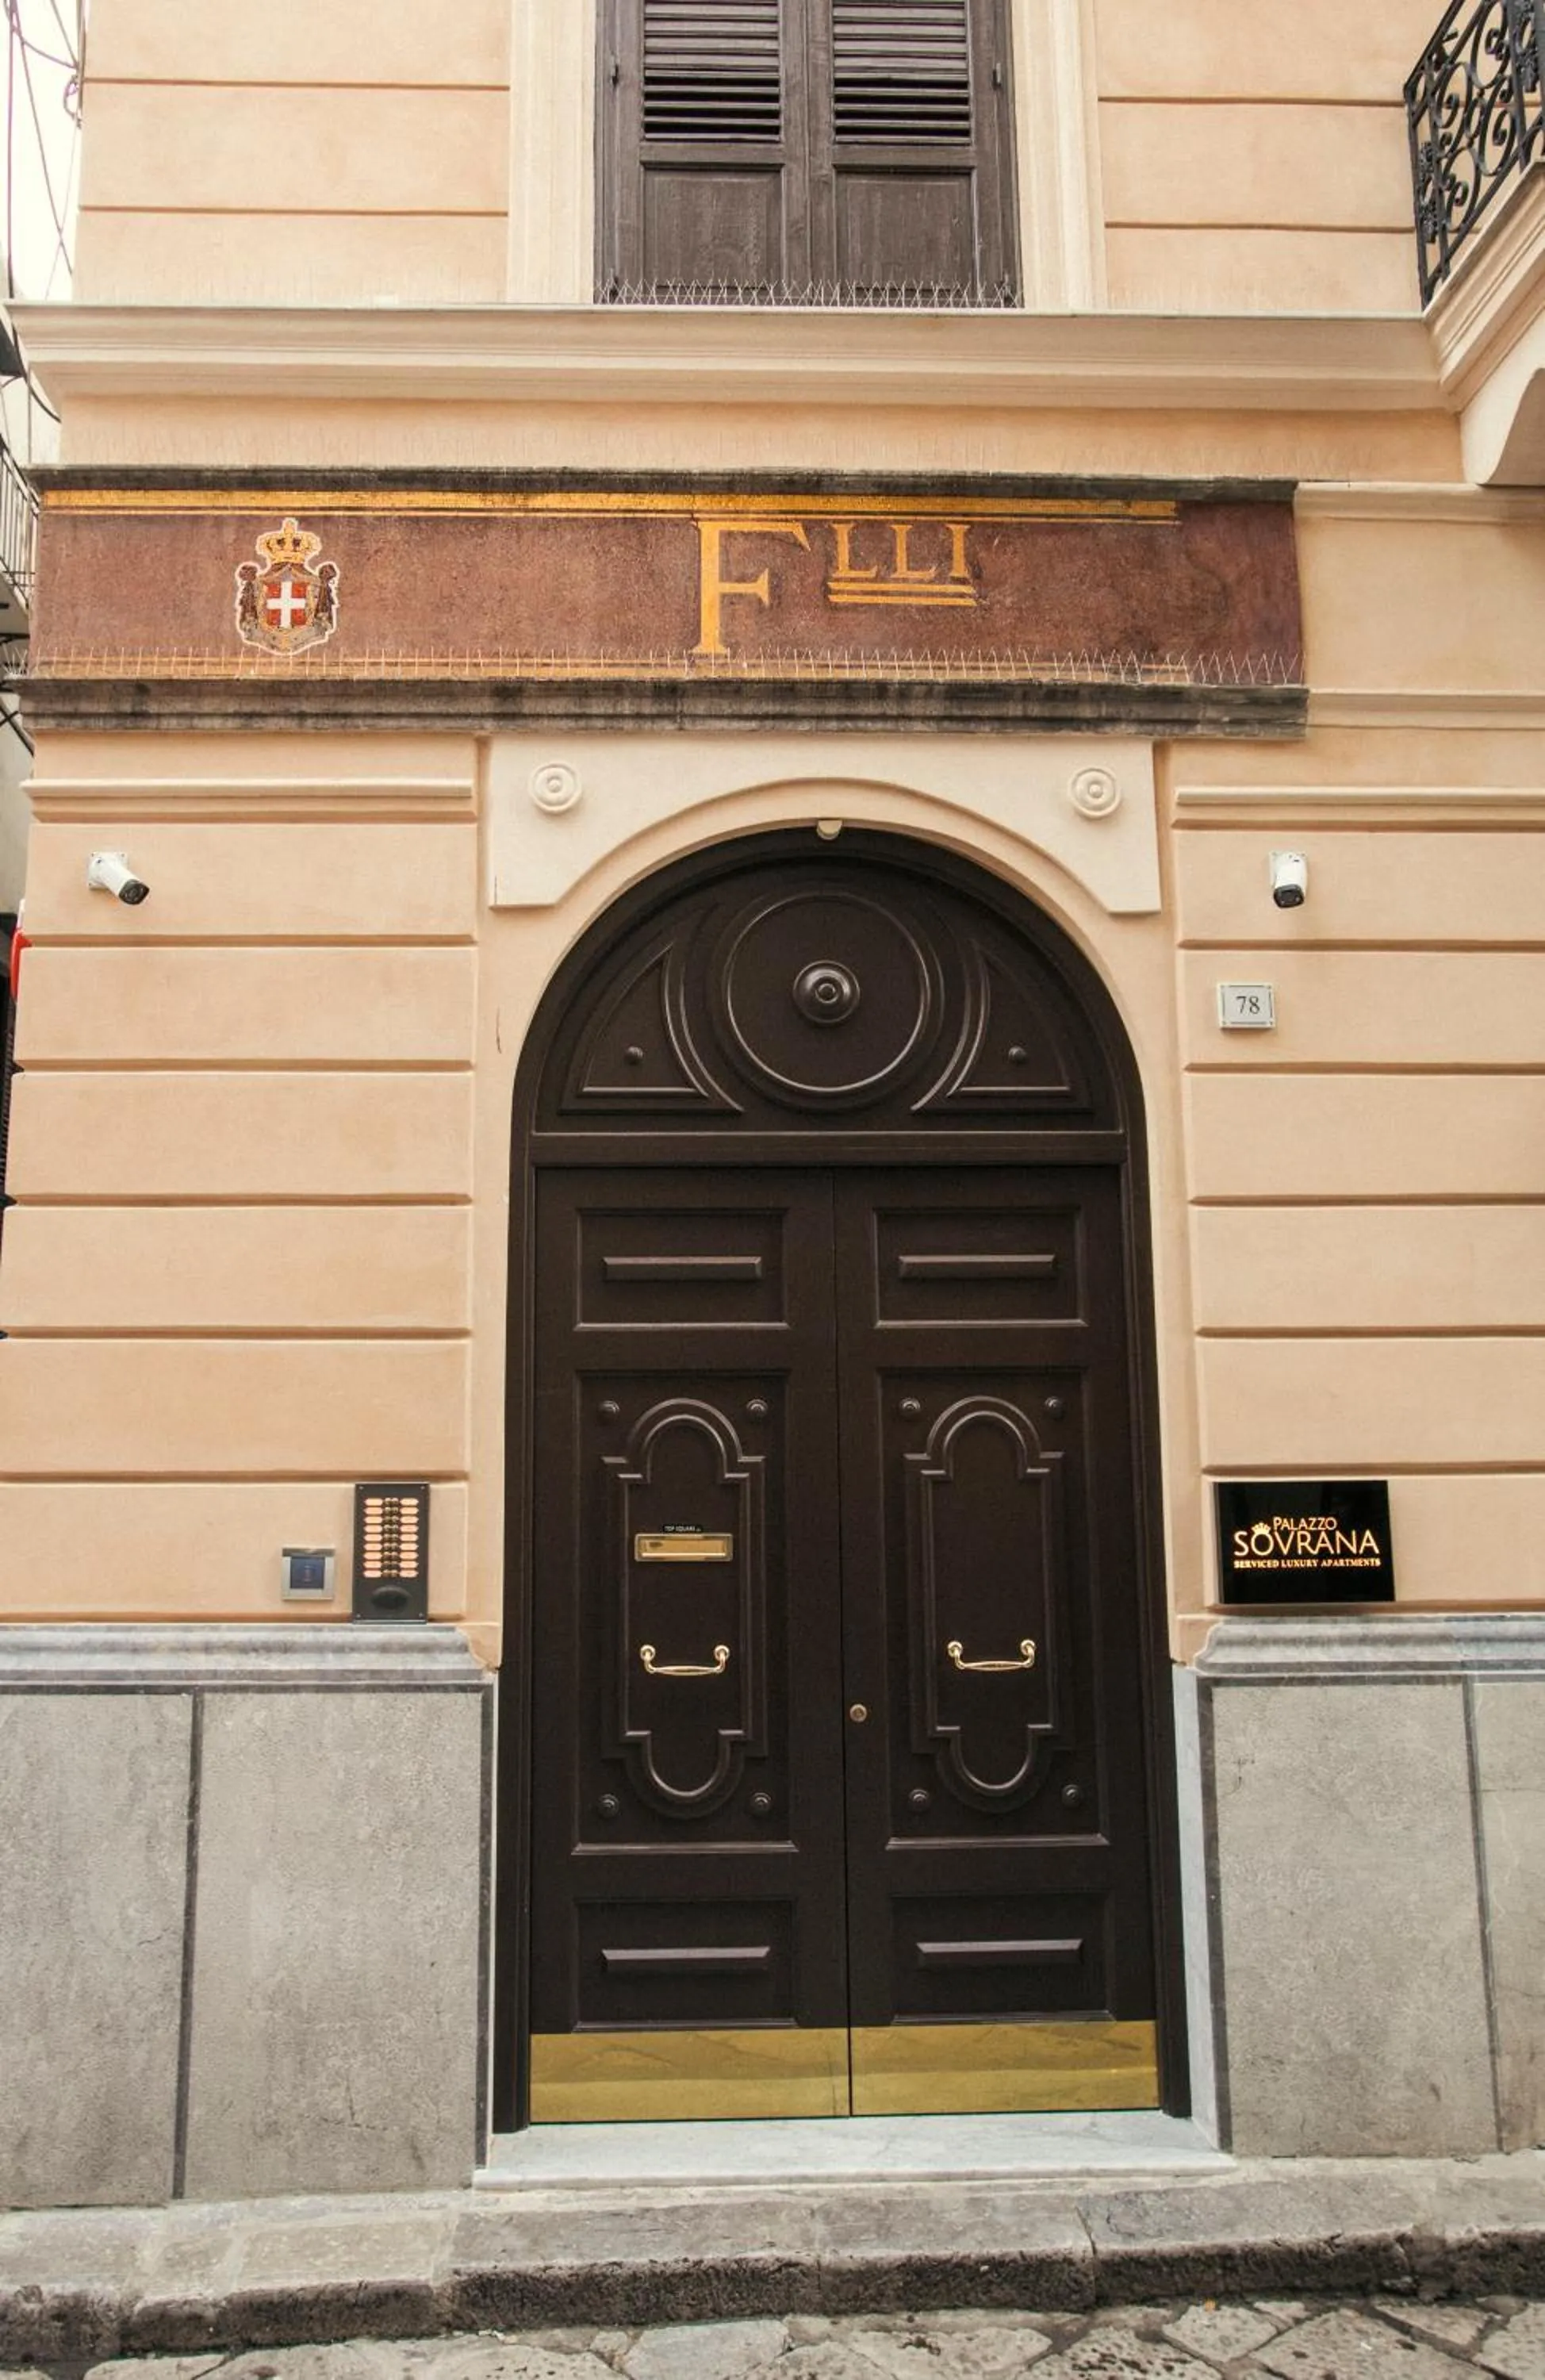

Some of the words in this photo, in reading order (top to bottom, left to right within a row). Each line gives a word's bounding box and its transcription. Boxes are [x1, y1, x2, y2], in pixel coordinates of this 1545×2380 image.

[1236, 996, 1260, 1015] 78
[1273, 1516, 1337, 1531] PALAZZO
[1233, 1530, 1380, 1557] SOVRANA
[1233, 1559, 1279, 1568] SERVICED
[1281, 1559, 1318, 1568] LUXURY
[1321, 1558, 1381, 1567] APARTMENTS
